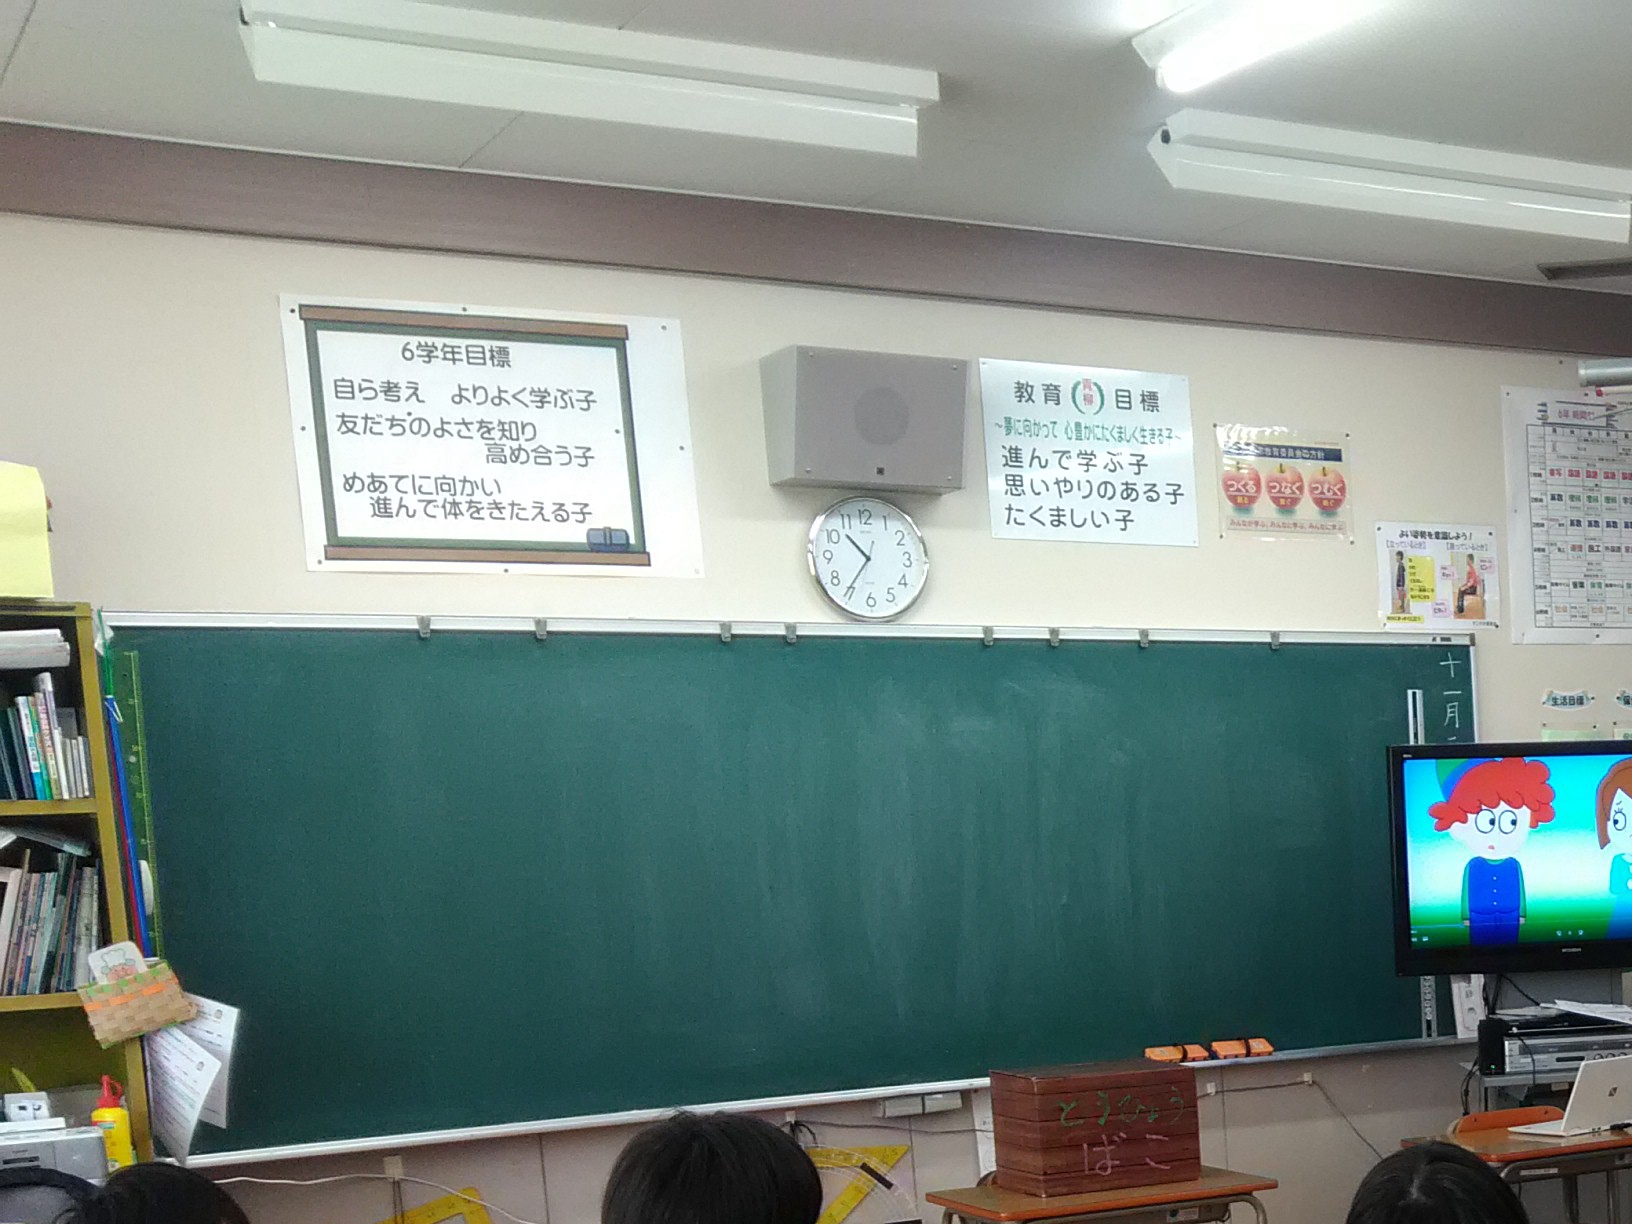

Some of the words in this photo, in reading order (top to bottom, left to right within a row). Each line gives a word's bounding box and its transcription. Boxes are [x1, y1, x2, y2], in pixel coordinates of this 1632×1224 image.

[401, 341, 511, 368] 6学年目標
[334, 378, 425, 403] 自ら考え
[451, 384, 597, 411] よりよく学ぶ子
[1013, 380, 1061, 406] 教育
[1115, 389, 1160, 413] 目標
[336, 412, 537, 441] 友だちのよさを知り
[485, 442, 594, 467] 高め合う子
[1001, 445, 1148, 475] 進んで学ぶ子
[343, 472, 501, 496] めあてに向かい
[1004, 473, 1184, 505] 思いやりのある子
[370, 496, 592, 523] 進んで体をきたえる子
[841, 514, 851, 529] 11
[858, 509, 872, 525] 12
[1004, 504, 1134, 531] たくましい子
[826, 529, 840, 544] 10
[895, 530, 905, 546] 2
[823, 550, 833, 564] 9
[902, 551, 912, 568] 3
[830, 570, 840, 586] 8
[898, 573, 908, 587] 4
[866, 592, 876, 607] 6
[886, 587, 896, 603] 5
[1440, 652, 1462, 740] 十一月
[1057, 1087, 1185, 1126] とうひょう
[1083, 1132, 1171, 1175] ばこ
